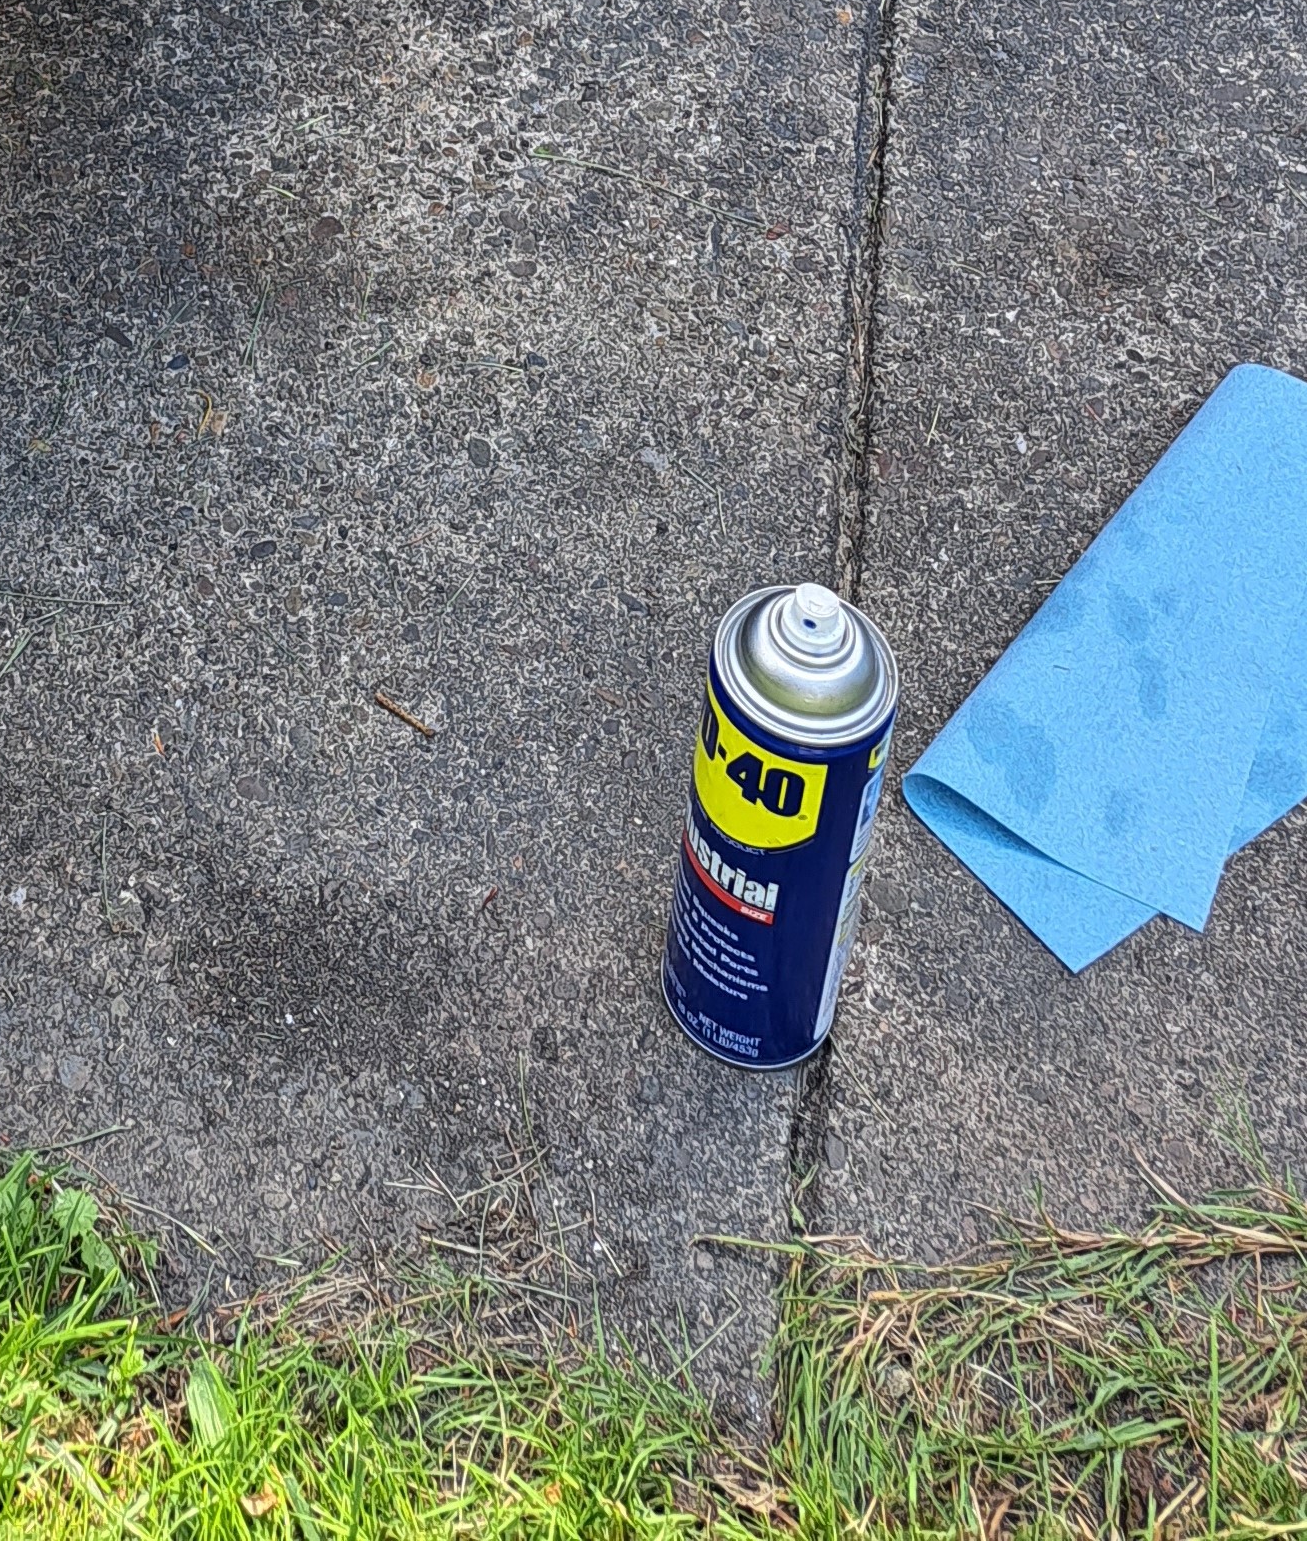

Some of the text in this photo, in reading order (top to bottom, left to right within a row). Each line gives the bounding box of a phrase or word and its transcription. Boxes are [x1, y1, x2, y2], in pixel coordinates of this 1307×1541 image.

[740, 905, 767, 922] SIZE
[701, 920, 756, 963] Protects
[691, 939, 768, 992] Mechanisms
[693, 957, 748, 1001] Moisture
[720, 952, 759, 977] Parts
[698, 1011, 762, 1048] NET WEIGHT
